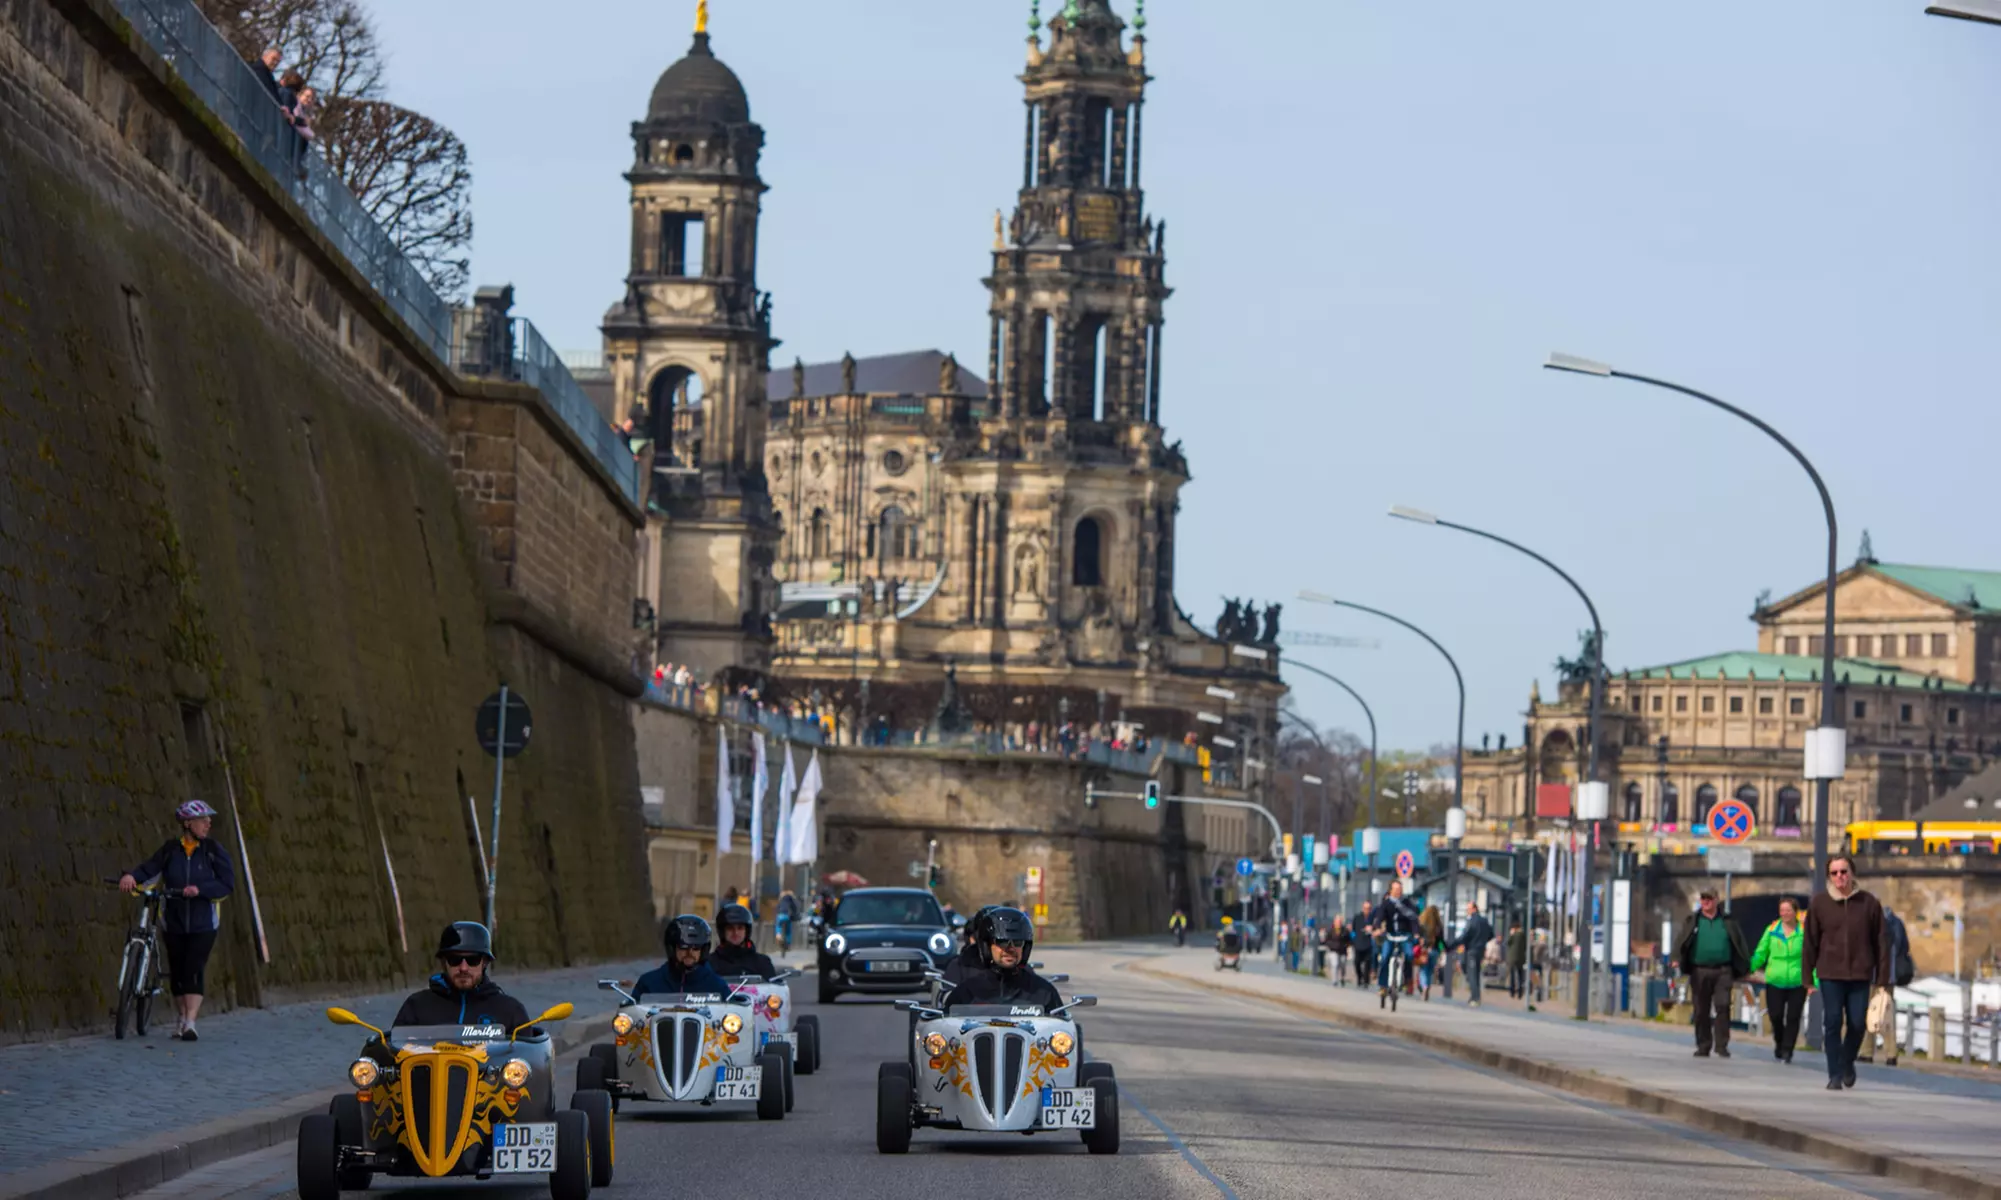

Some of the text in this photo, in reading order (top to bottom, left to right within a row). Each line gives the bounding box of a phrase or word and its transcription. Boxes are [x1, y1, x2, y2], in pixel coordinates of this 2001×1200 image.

[1010, 1006, 1041, 1017] Dorothy
[461, 1025, 502, 1038] Marilyn
[726, 1067, 743, 1081] DD
[718, 1084, 756, 1098] CT 41
[1052, 1091, 1073, 1107] DD
[1045, 1109, 1091, 1126] CT 42
[506, 1126, 531, 1147] DD
[496, 1148, 552, 1170] CT 52
